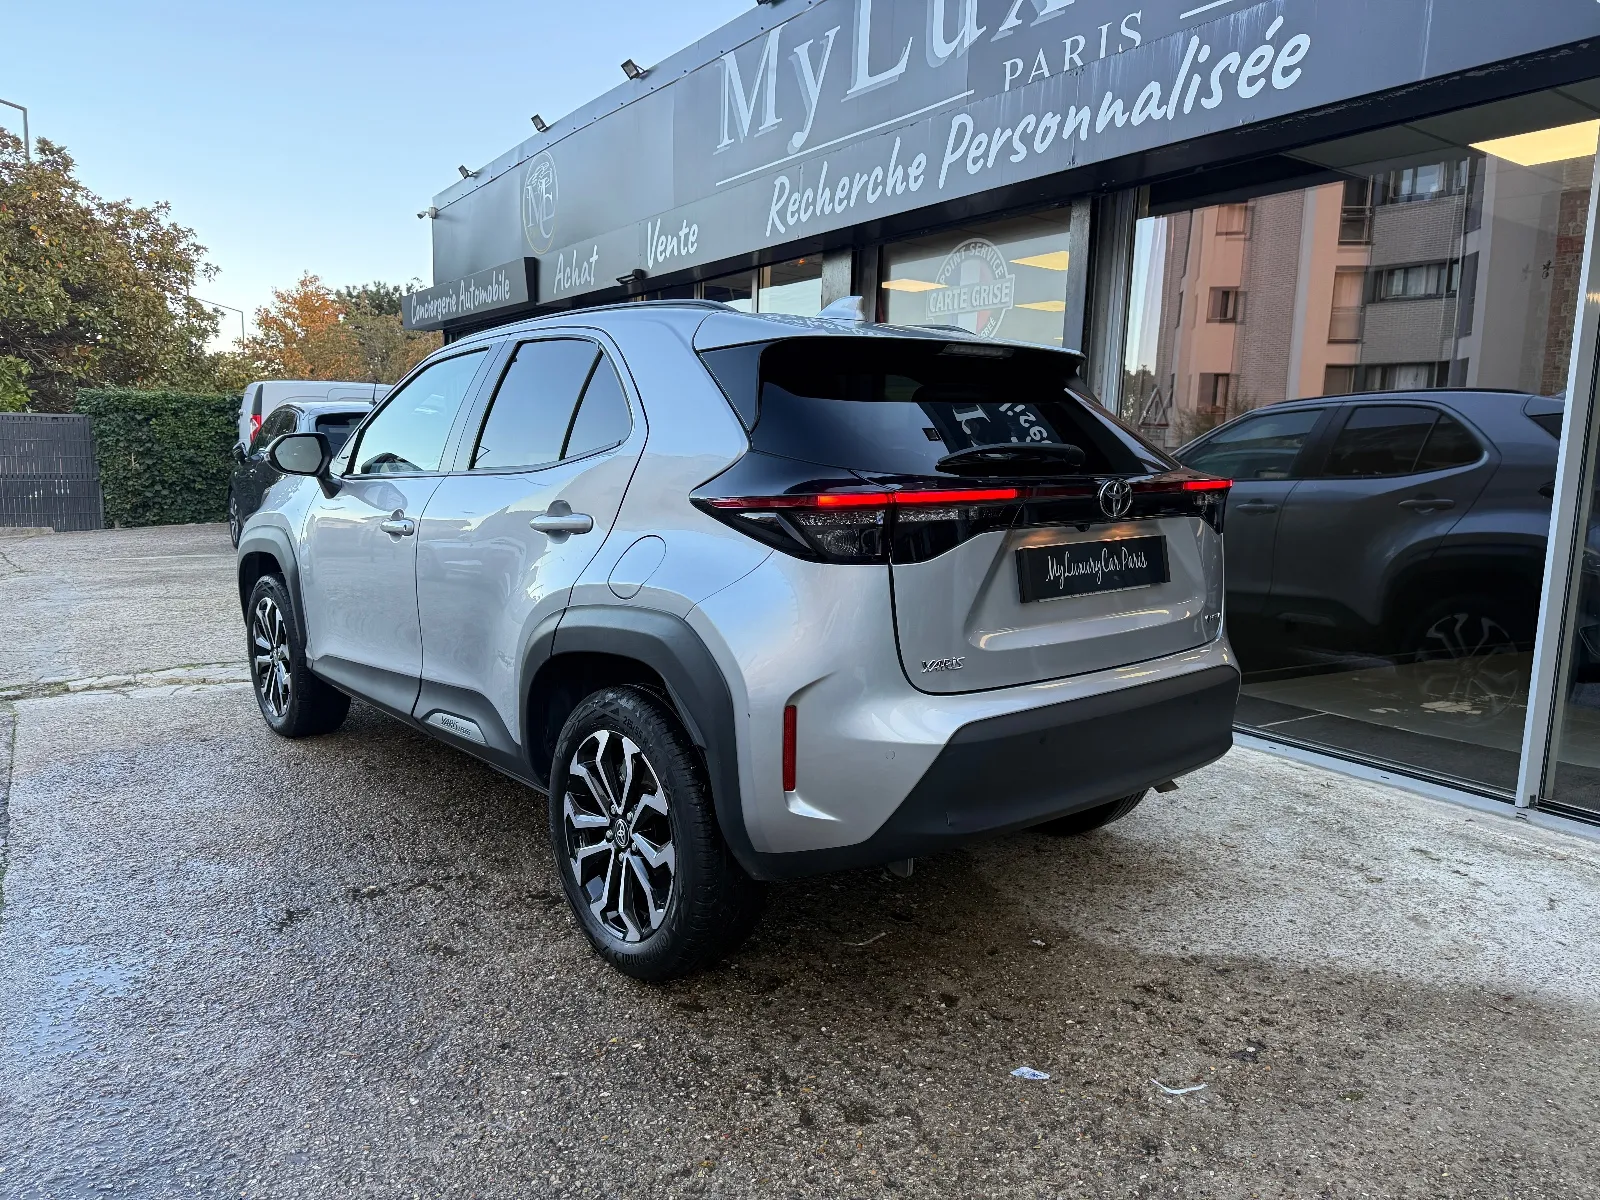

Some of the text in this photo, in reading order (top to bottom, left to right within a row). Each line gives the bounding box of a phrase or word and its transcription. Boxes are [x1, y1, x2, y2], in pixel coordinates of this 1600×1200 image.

[1002, 9, 1142, 92] PARIS
[765, 15, 1311, 237] Recherche Personnalisée
[553, 244, 598, 294] Achat
[647, 218, 699, 270] Vente
[939, 242, 1005, 285] POINT SERVICE
[411, 269, 511, 325] Conciergerie Automobile
[928, 281, 1011, 313] CARTE GRISE
[1122, 546, 1148, 571] Paris
